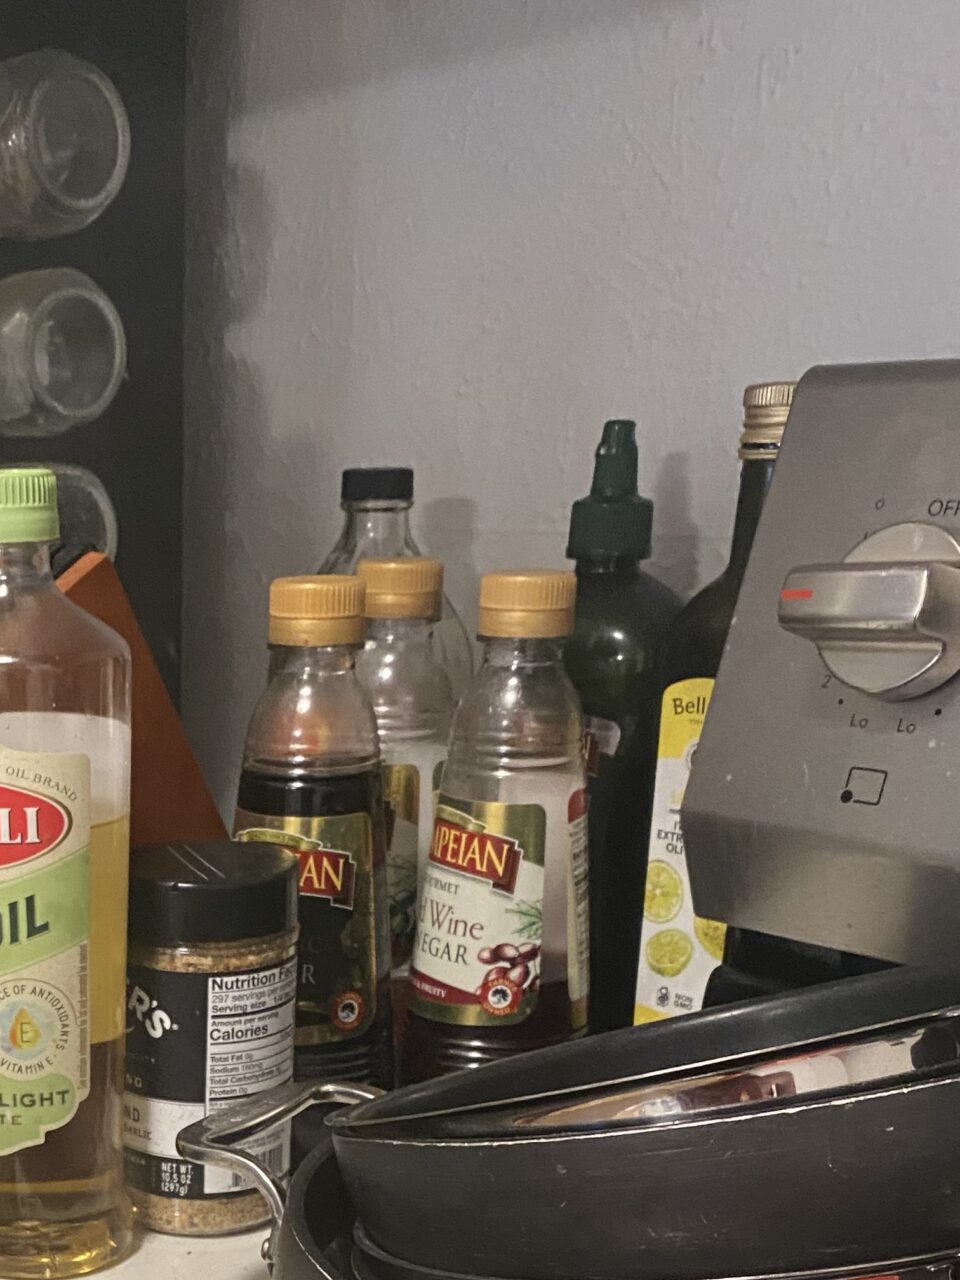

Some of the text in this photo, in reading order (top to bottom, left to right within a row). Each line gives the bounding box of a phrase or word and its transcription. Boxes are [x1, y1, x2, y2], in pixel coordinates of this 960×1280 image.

[821, 675, 831, 688] 2
[849, 713, 916, 734] Lo Lo
[5, 765, 29, 780] OIL
[33, 773, 78, 802] BRAND
[430, 898, 485, 941] Wine
[212, 972, 276, 992] Nutrition
[212, 994, 229, 1004] 297
[232, 990, 266, 1003] servings
[212, 1001, 266, 1014] Serving size
[13, 984, 27, 996] OF
[30, 985, 70, 1052] ANTIOXIDANTS
[211, 1019, 242, 1028] Amount
[20, 1022, 32, 1044] E
[210, 1025, 268, 1041] Calories
[0, 1056, 54, 1075] VITAMIN E
[211, 1055, 229, 1063] Total
[231, 1054, 243, 1062] Fat
[210, 1066, 239, 1074] Sodium
[210, 1077, 229, 1086] Total
[209, 1088, 237, 1097] Protein
[161, 1162, 177, 1173] NET
[161, 1173, 192, 1184] 10.5 OZ
[161, 1182, 189, 1197] (297g)
